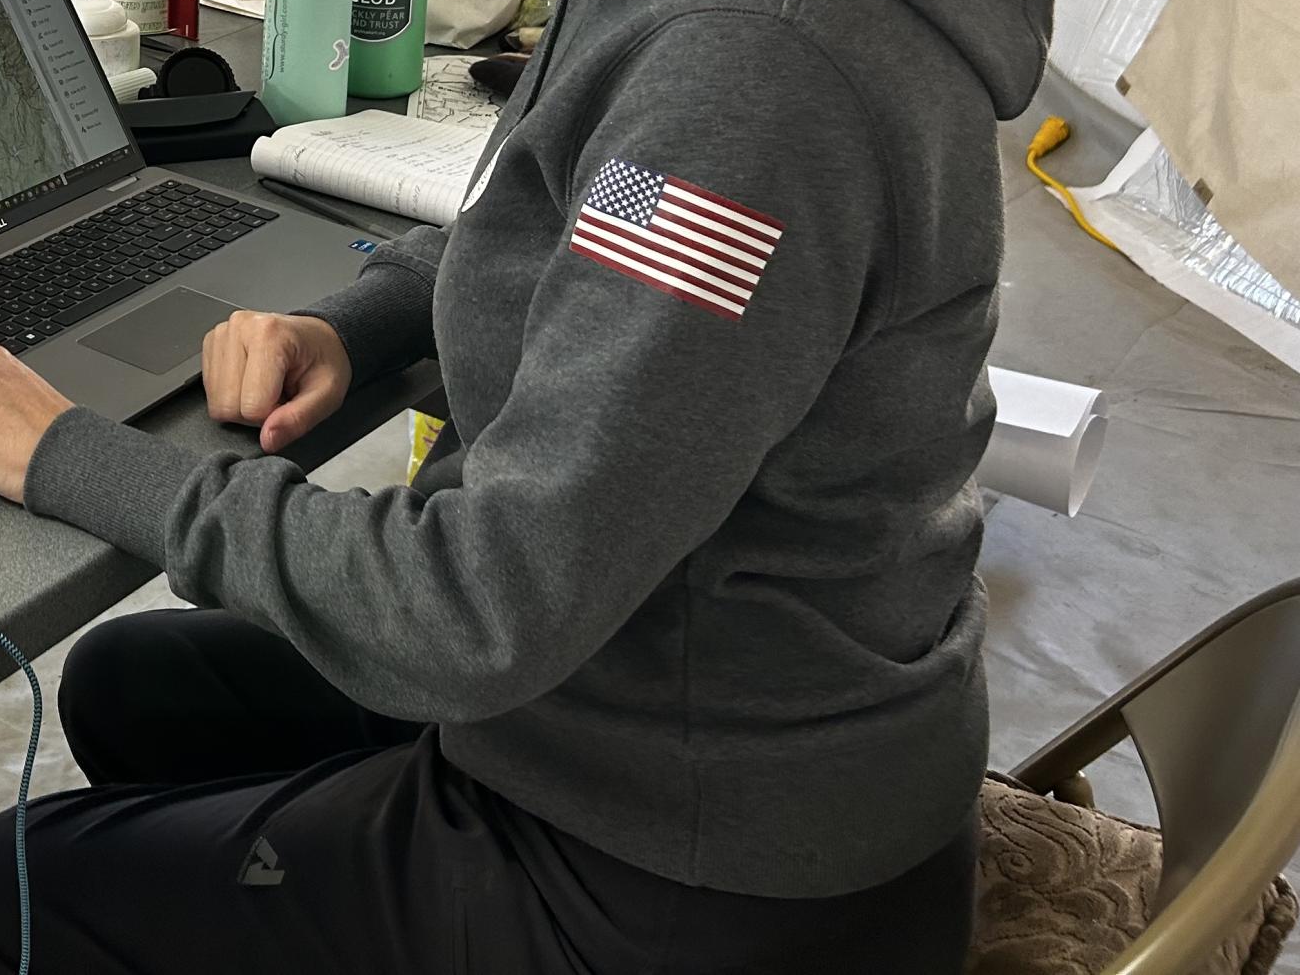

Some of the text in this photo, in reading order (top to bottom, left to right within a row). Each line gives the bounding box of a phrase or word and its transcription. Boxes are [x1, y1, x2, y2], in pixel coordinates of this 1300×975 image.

[352, 9, 376, 20] CKLY
[352, 18, 400, 30] ND TRUST
